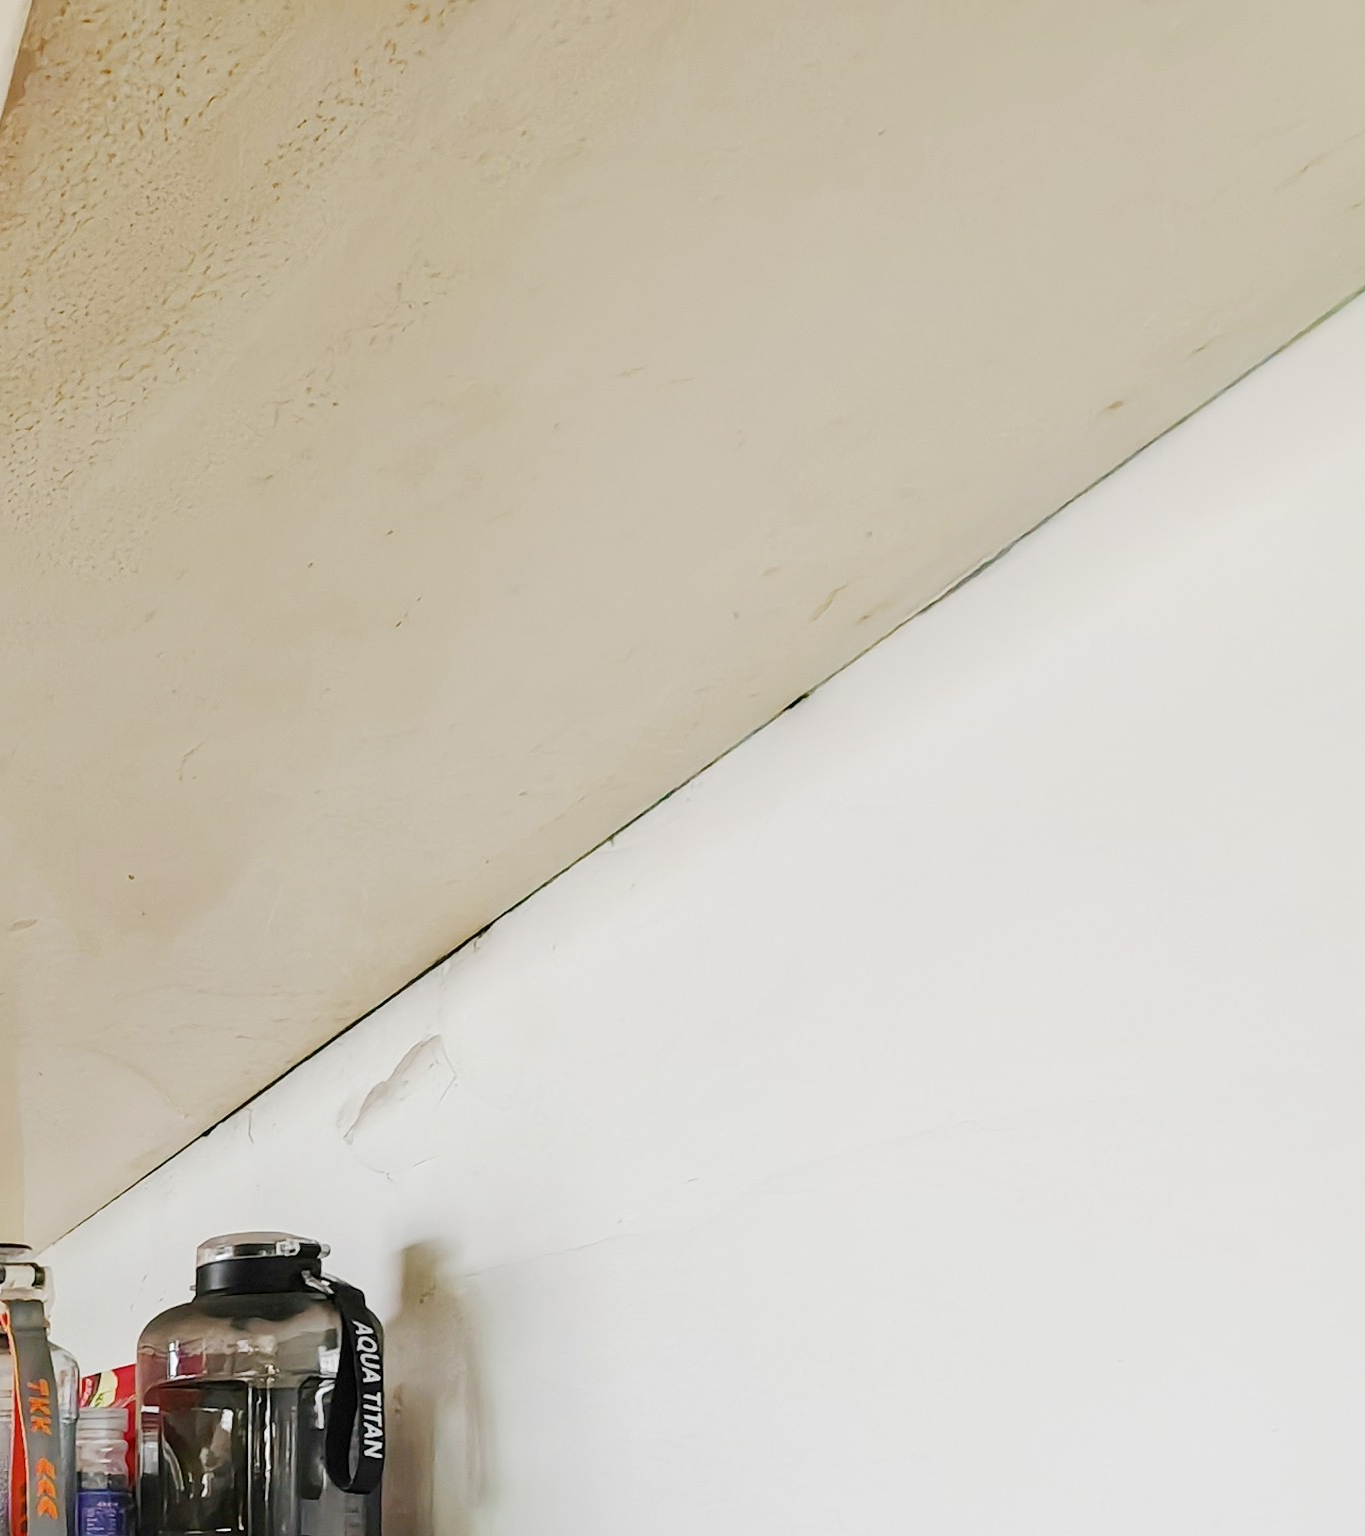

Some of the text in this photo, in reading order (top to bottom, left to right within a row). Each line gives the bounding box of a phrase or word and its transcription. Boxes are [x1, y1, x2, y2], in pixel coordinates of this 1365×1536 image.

[26, 1378, 53, 1436] TKK
[351, 1319, 384, 1459] AQUA TITAN
